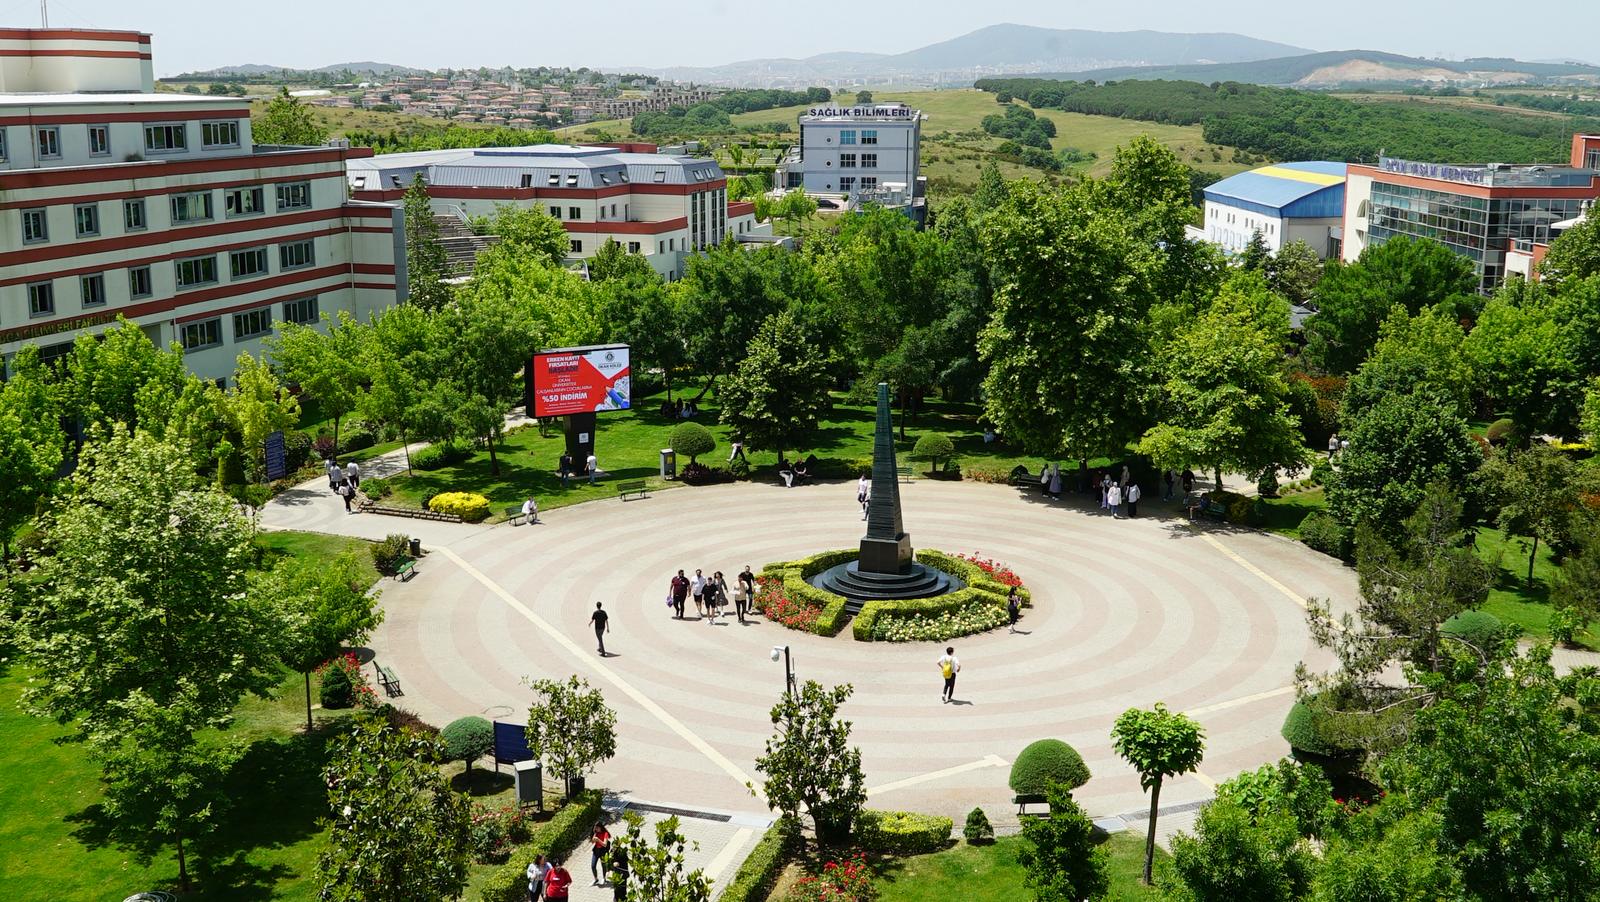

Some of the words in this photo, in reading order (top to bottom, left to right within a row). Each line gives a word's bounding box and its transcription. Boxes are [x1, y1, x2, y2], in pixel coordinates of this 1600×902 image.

[810, 108, 850, 116] SAĞLIK
[854, 108, 910, 116] BİLİMLERİ
[560, 392, 588, 400] İNDİRİM
